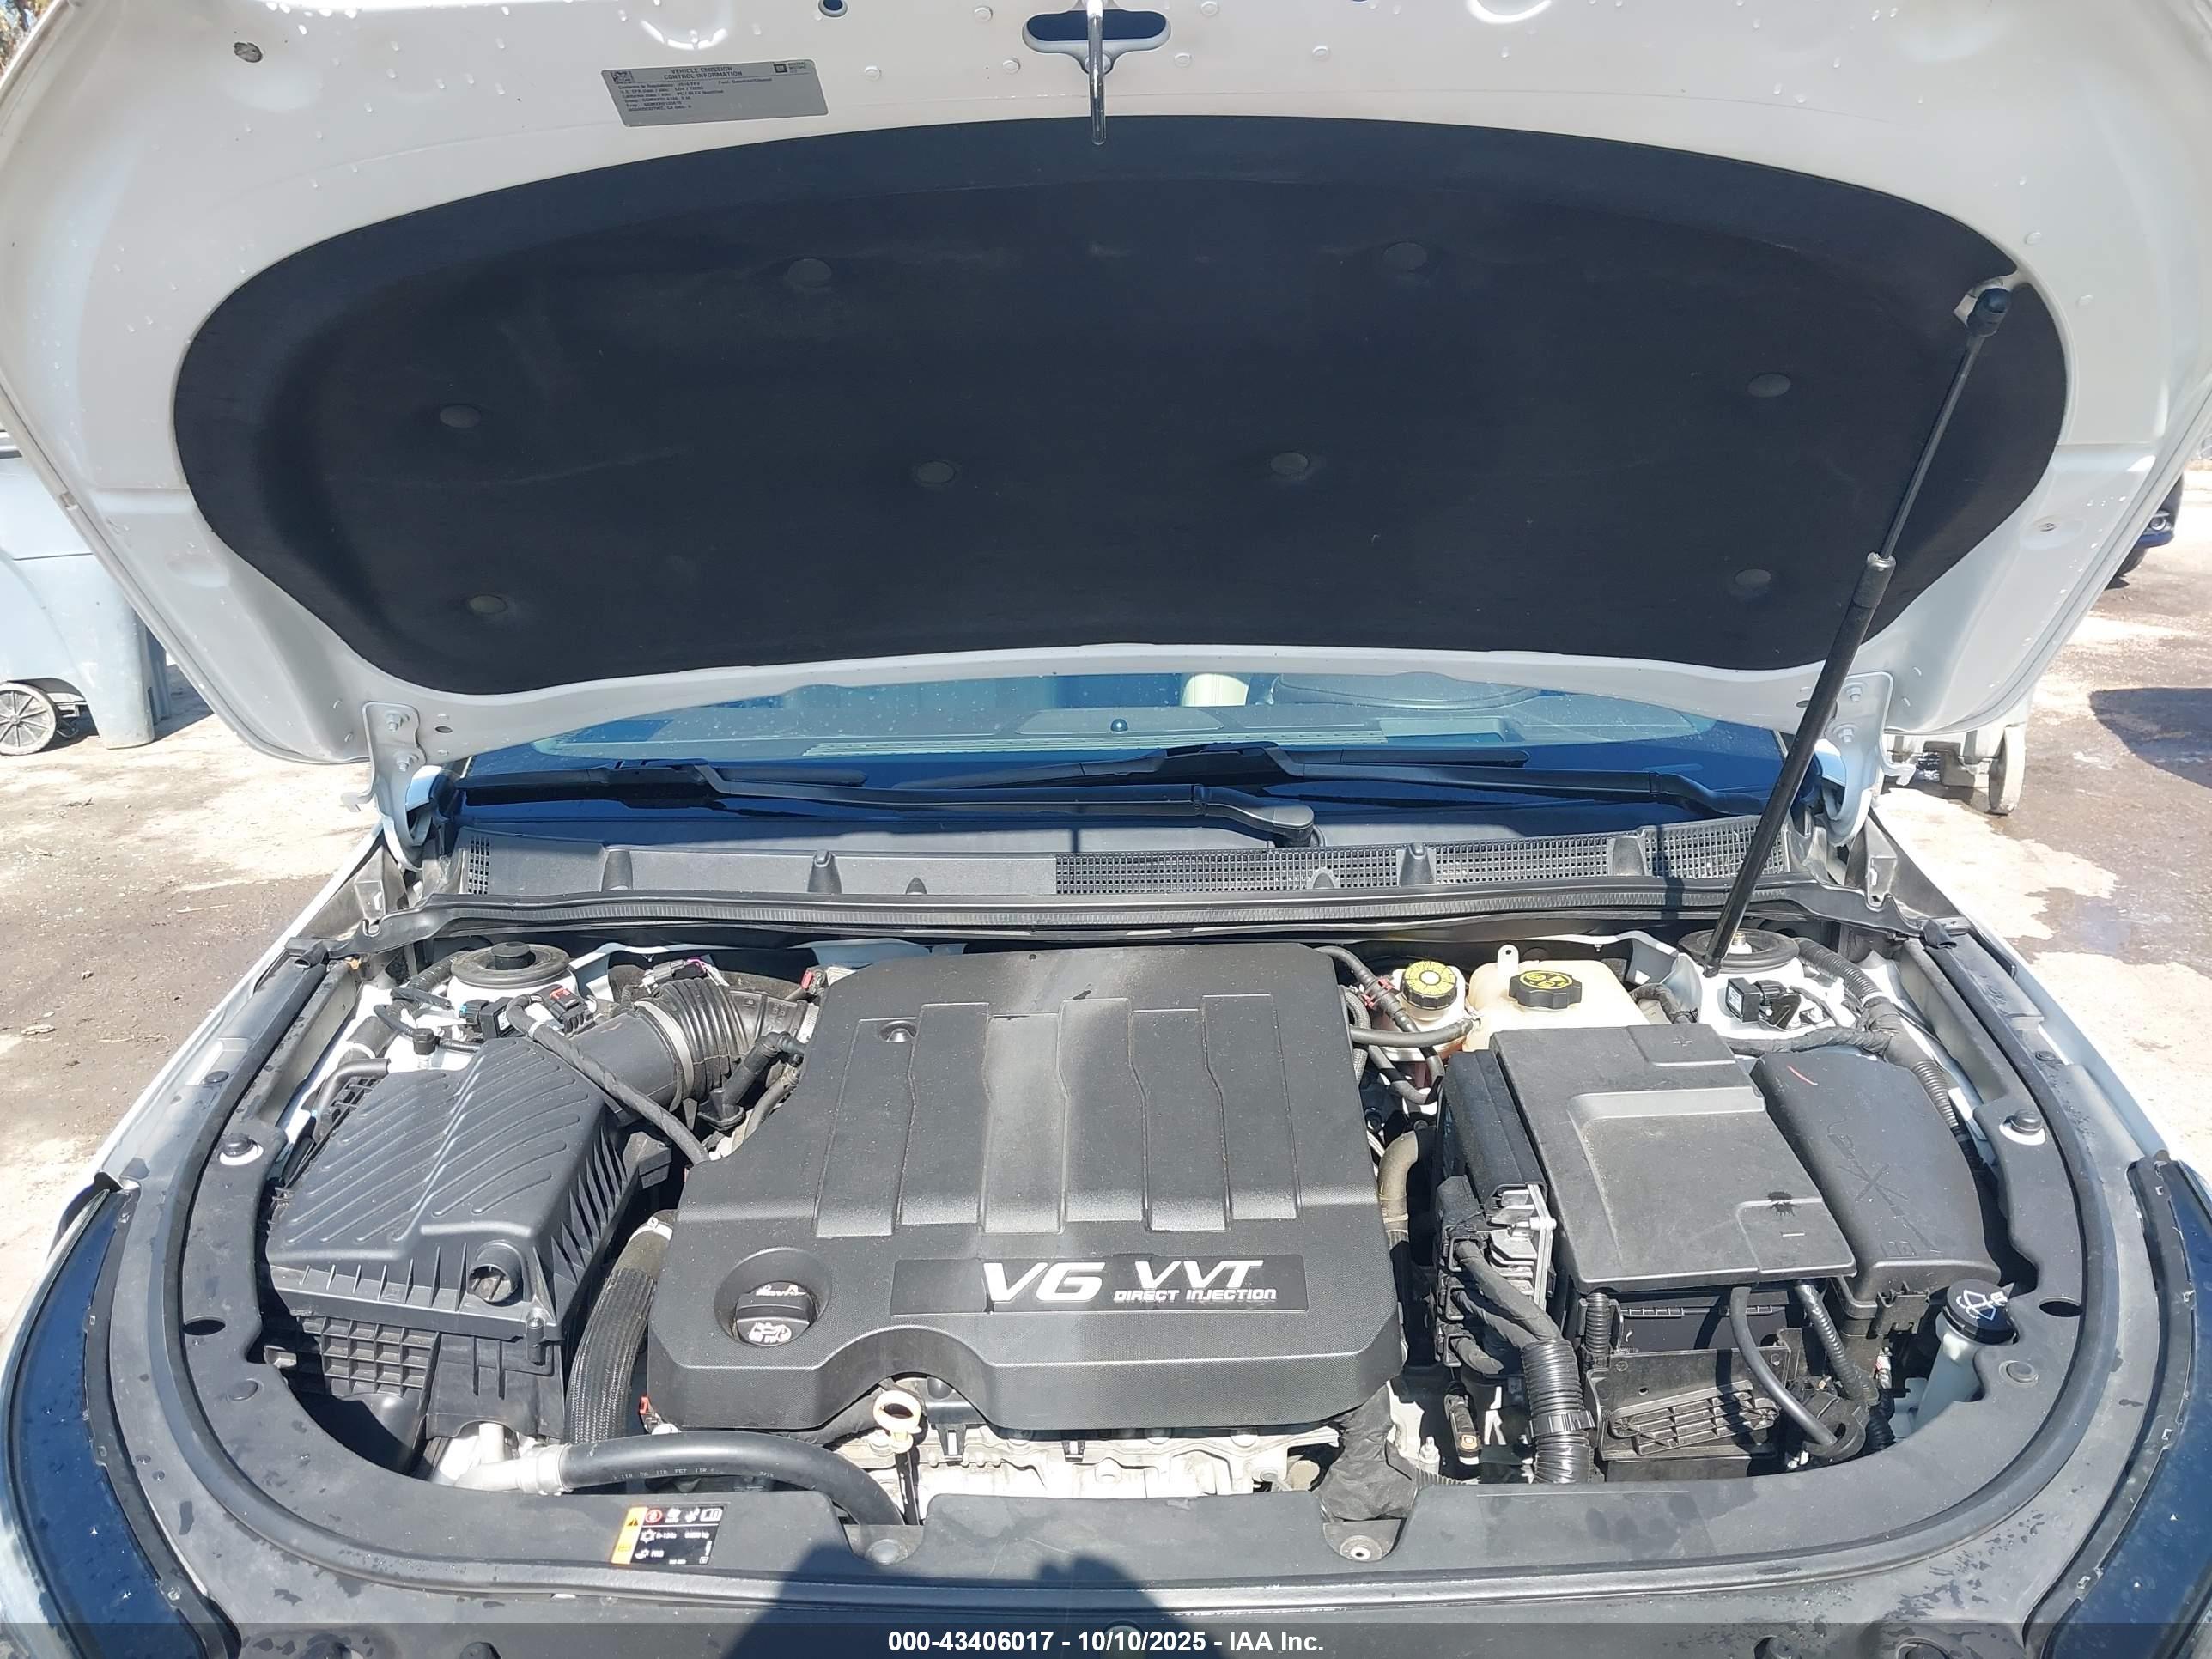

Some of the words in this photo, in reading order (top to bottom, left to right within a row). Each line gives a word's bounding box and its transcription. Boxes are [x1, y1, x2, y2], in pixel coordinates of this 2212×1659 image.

[983, 1262, 1106, 1302] V6
[1134, 1260, 1264, 1289] VVT
[1114, 1290, 1180, 1302] DIRECT
[1186, 1289, 1278, 1302] INJECTION
